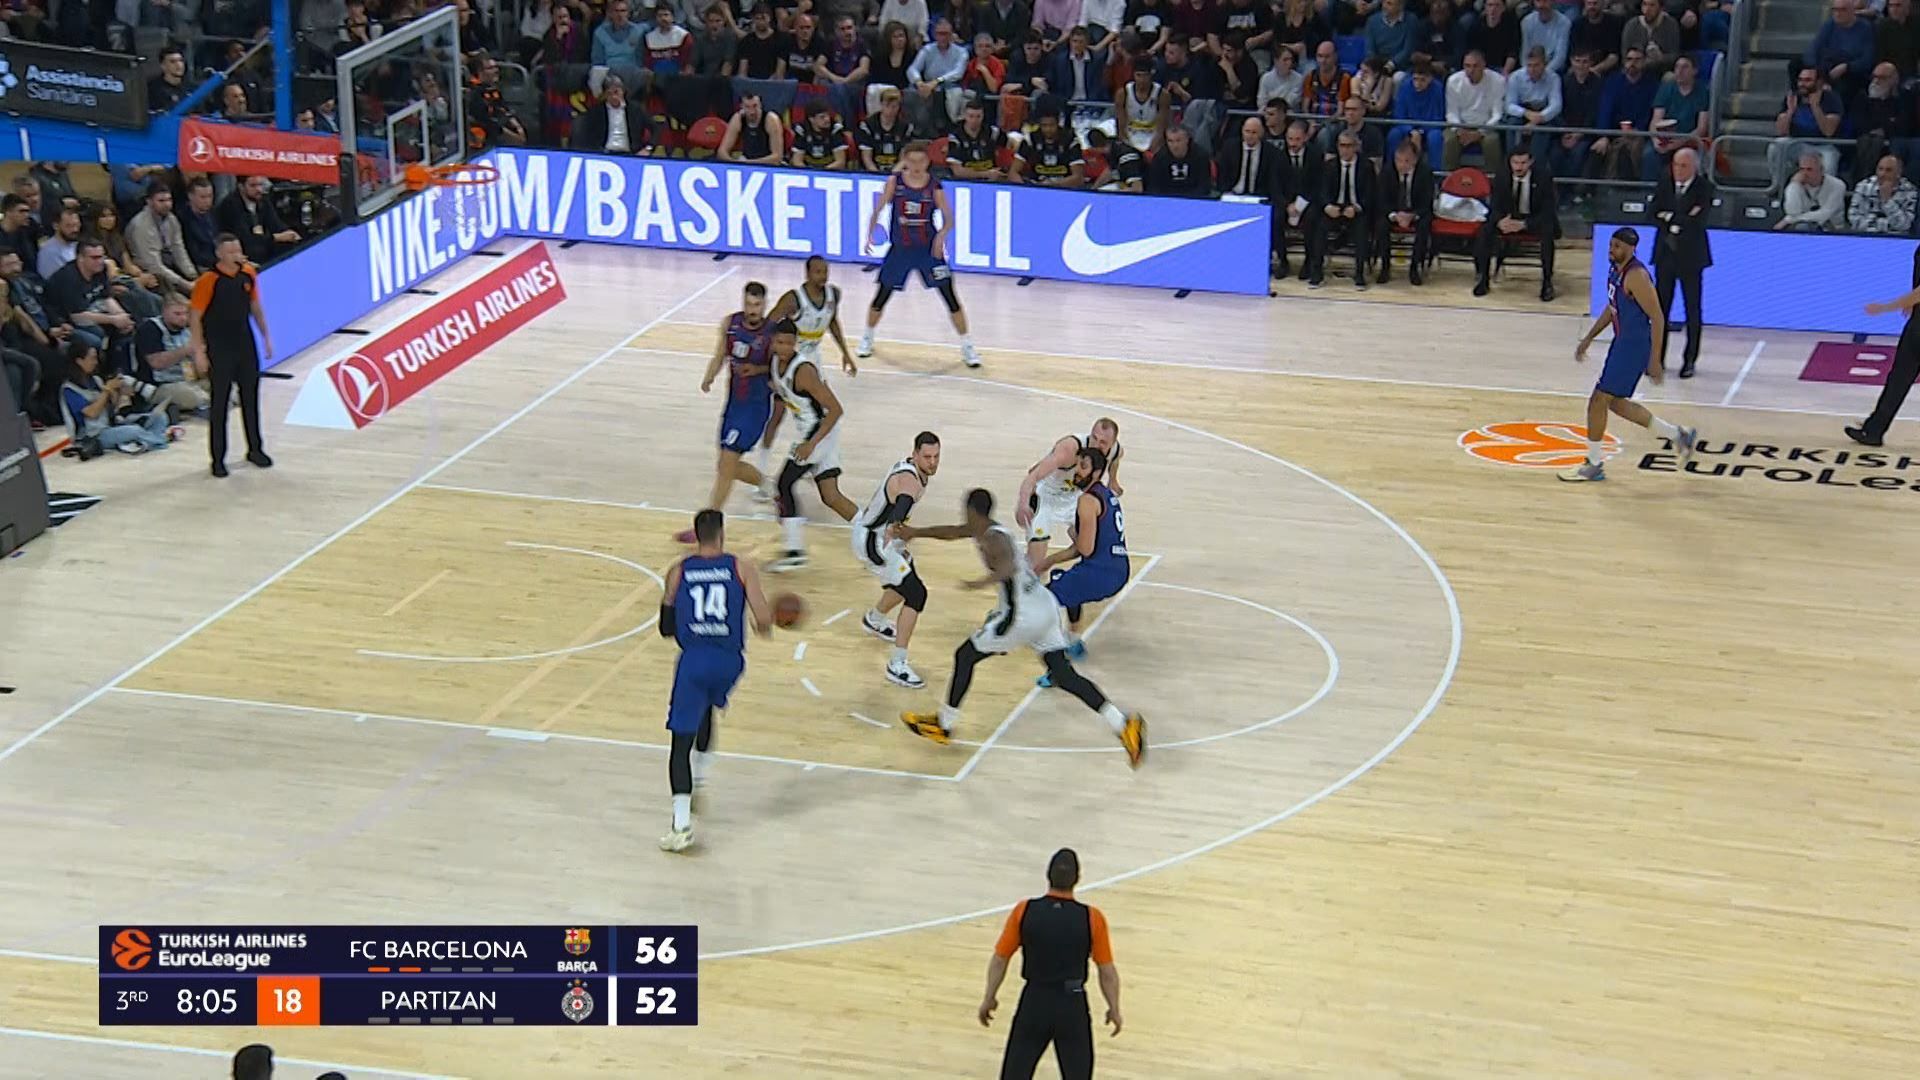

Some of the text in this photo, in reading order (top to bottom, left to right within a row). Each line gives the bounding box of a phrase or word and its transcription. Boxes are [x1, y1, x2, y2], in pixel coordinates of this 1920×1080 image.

[216, 146, 337, 166] TURKISH AIRLINES
[383, 260, 557, 380] TURKISH AIRLINES
[689, 583, 728, 622] 14
